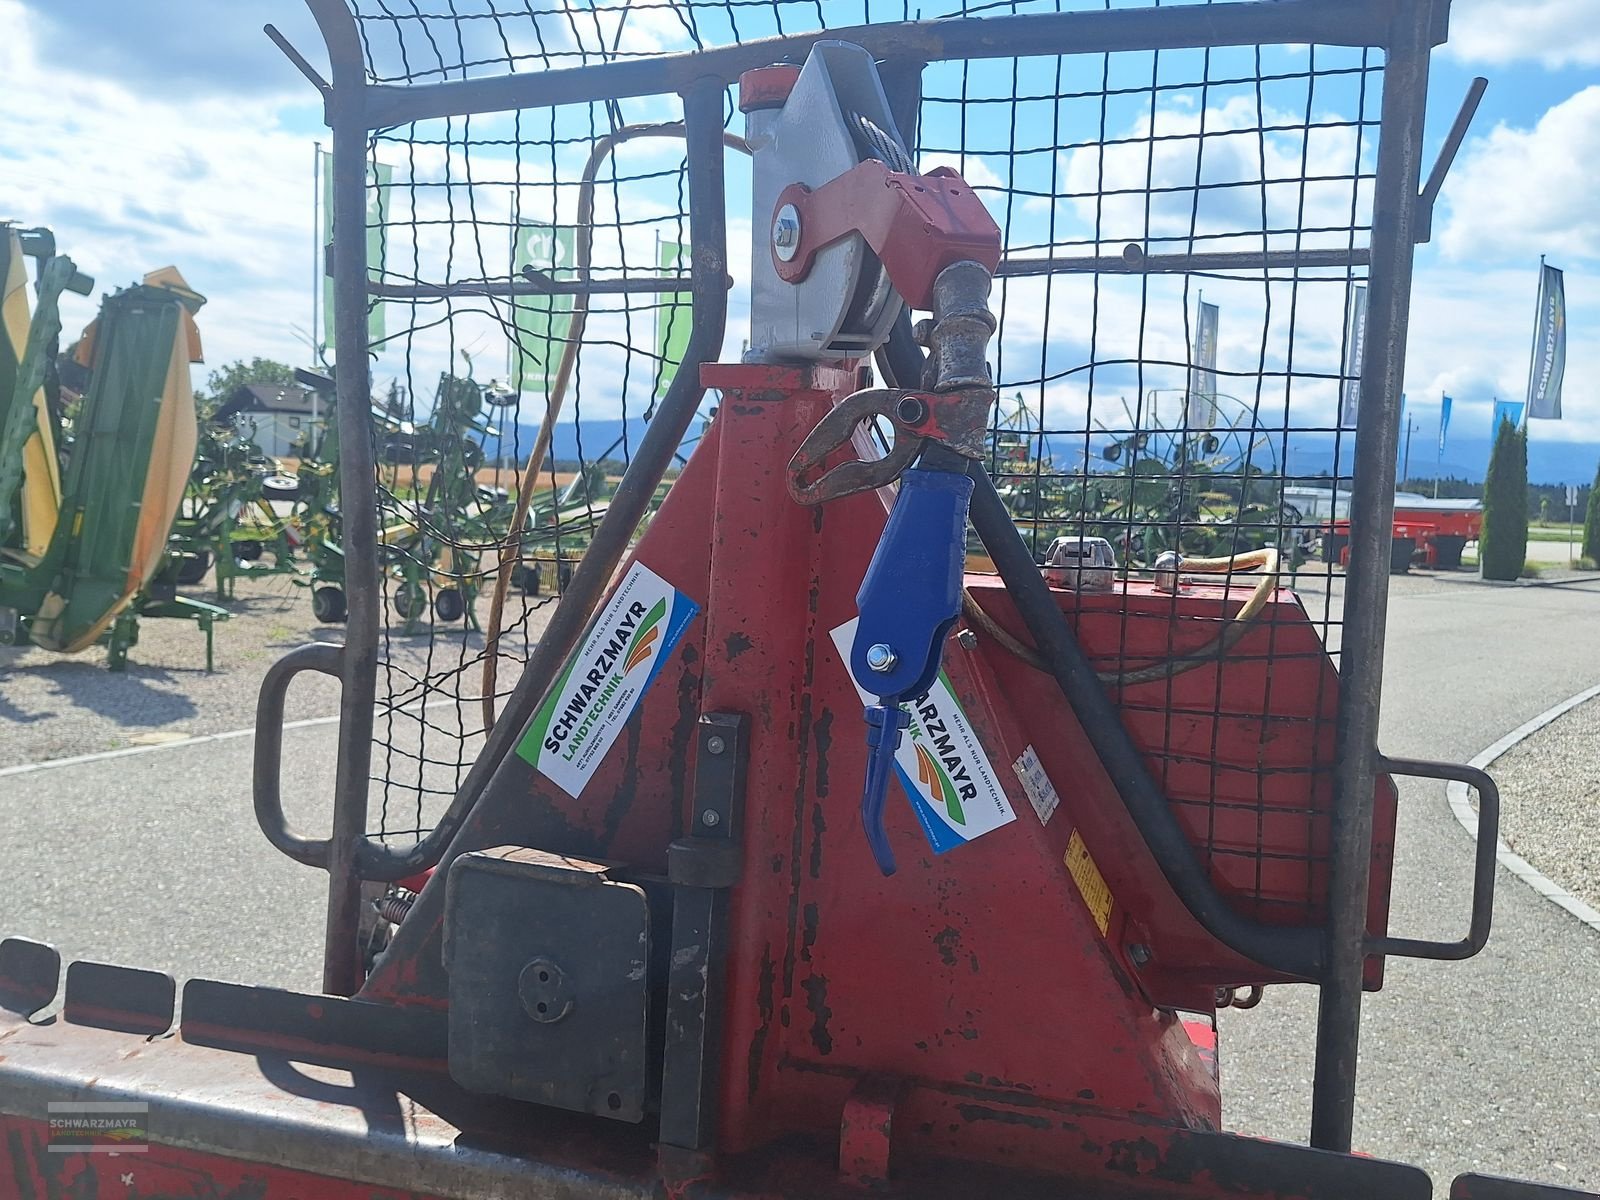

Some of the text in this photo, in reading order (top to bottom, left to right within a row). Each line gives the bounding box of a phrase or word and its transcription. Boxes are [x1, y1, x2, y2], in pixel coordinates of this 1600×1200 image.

[1537, 297, 1555, 399] SCHWARZMAYR
[585, 571, 641, 656] MEHR ALS NUR LANDTECHNIK.
[544, 601, 647, 755] SCHWARZMAYR
[562, 672, 624, 761] LANDTECHNIK
[914, 690, 977, 802] ARZMAYR
[952, 714, 1006, 816] MEHR ALS NUR LANDTECHNIK.
